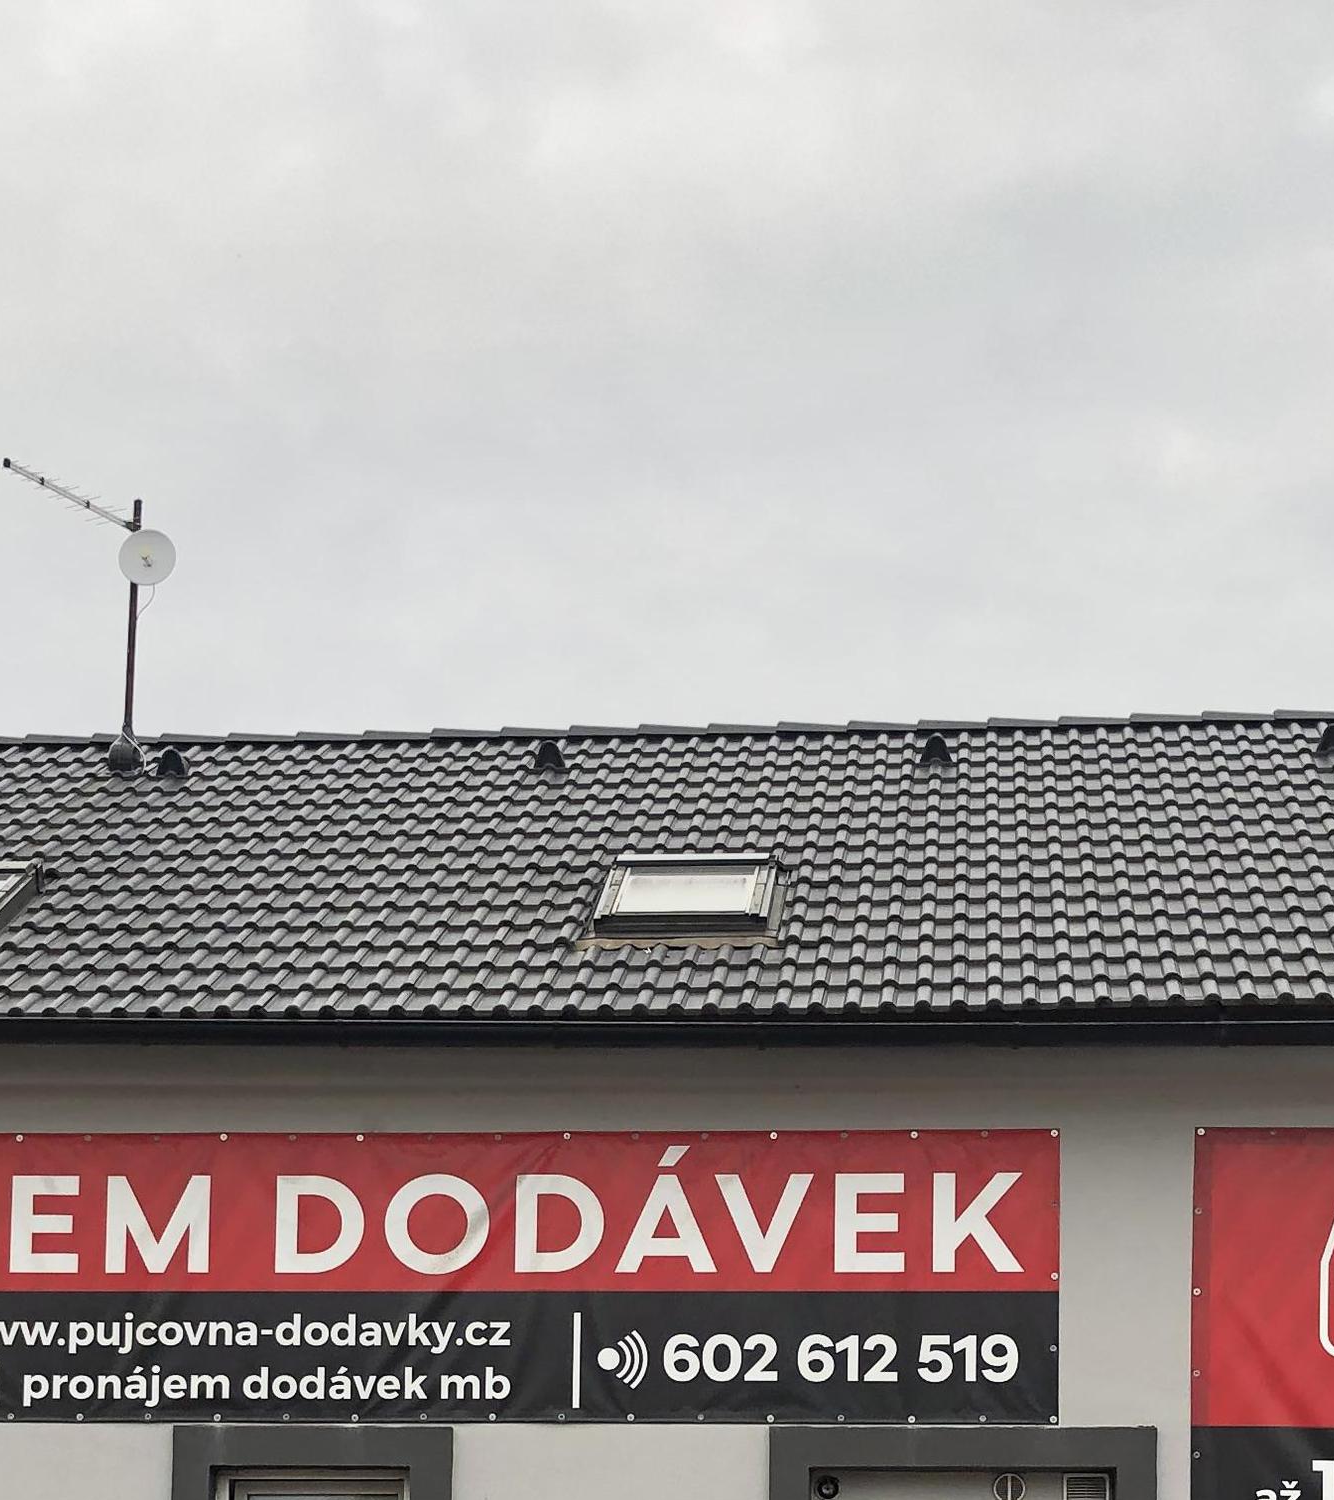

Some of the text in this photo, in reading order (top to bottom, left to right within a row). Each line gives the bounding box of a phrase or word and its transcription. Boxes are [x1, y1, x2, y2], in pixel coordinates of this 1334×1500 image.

[274, 1145, 1025, 1275] DODÁVEK
[663, 1333, 1019, 1383] 602 612 519
[22, 1364, 511, 1408] pronájem dodávek mb
